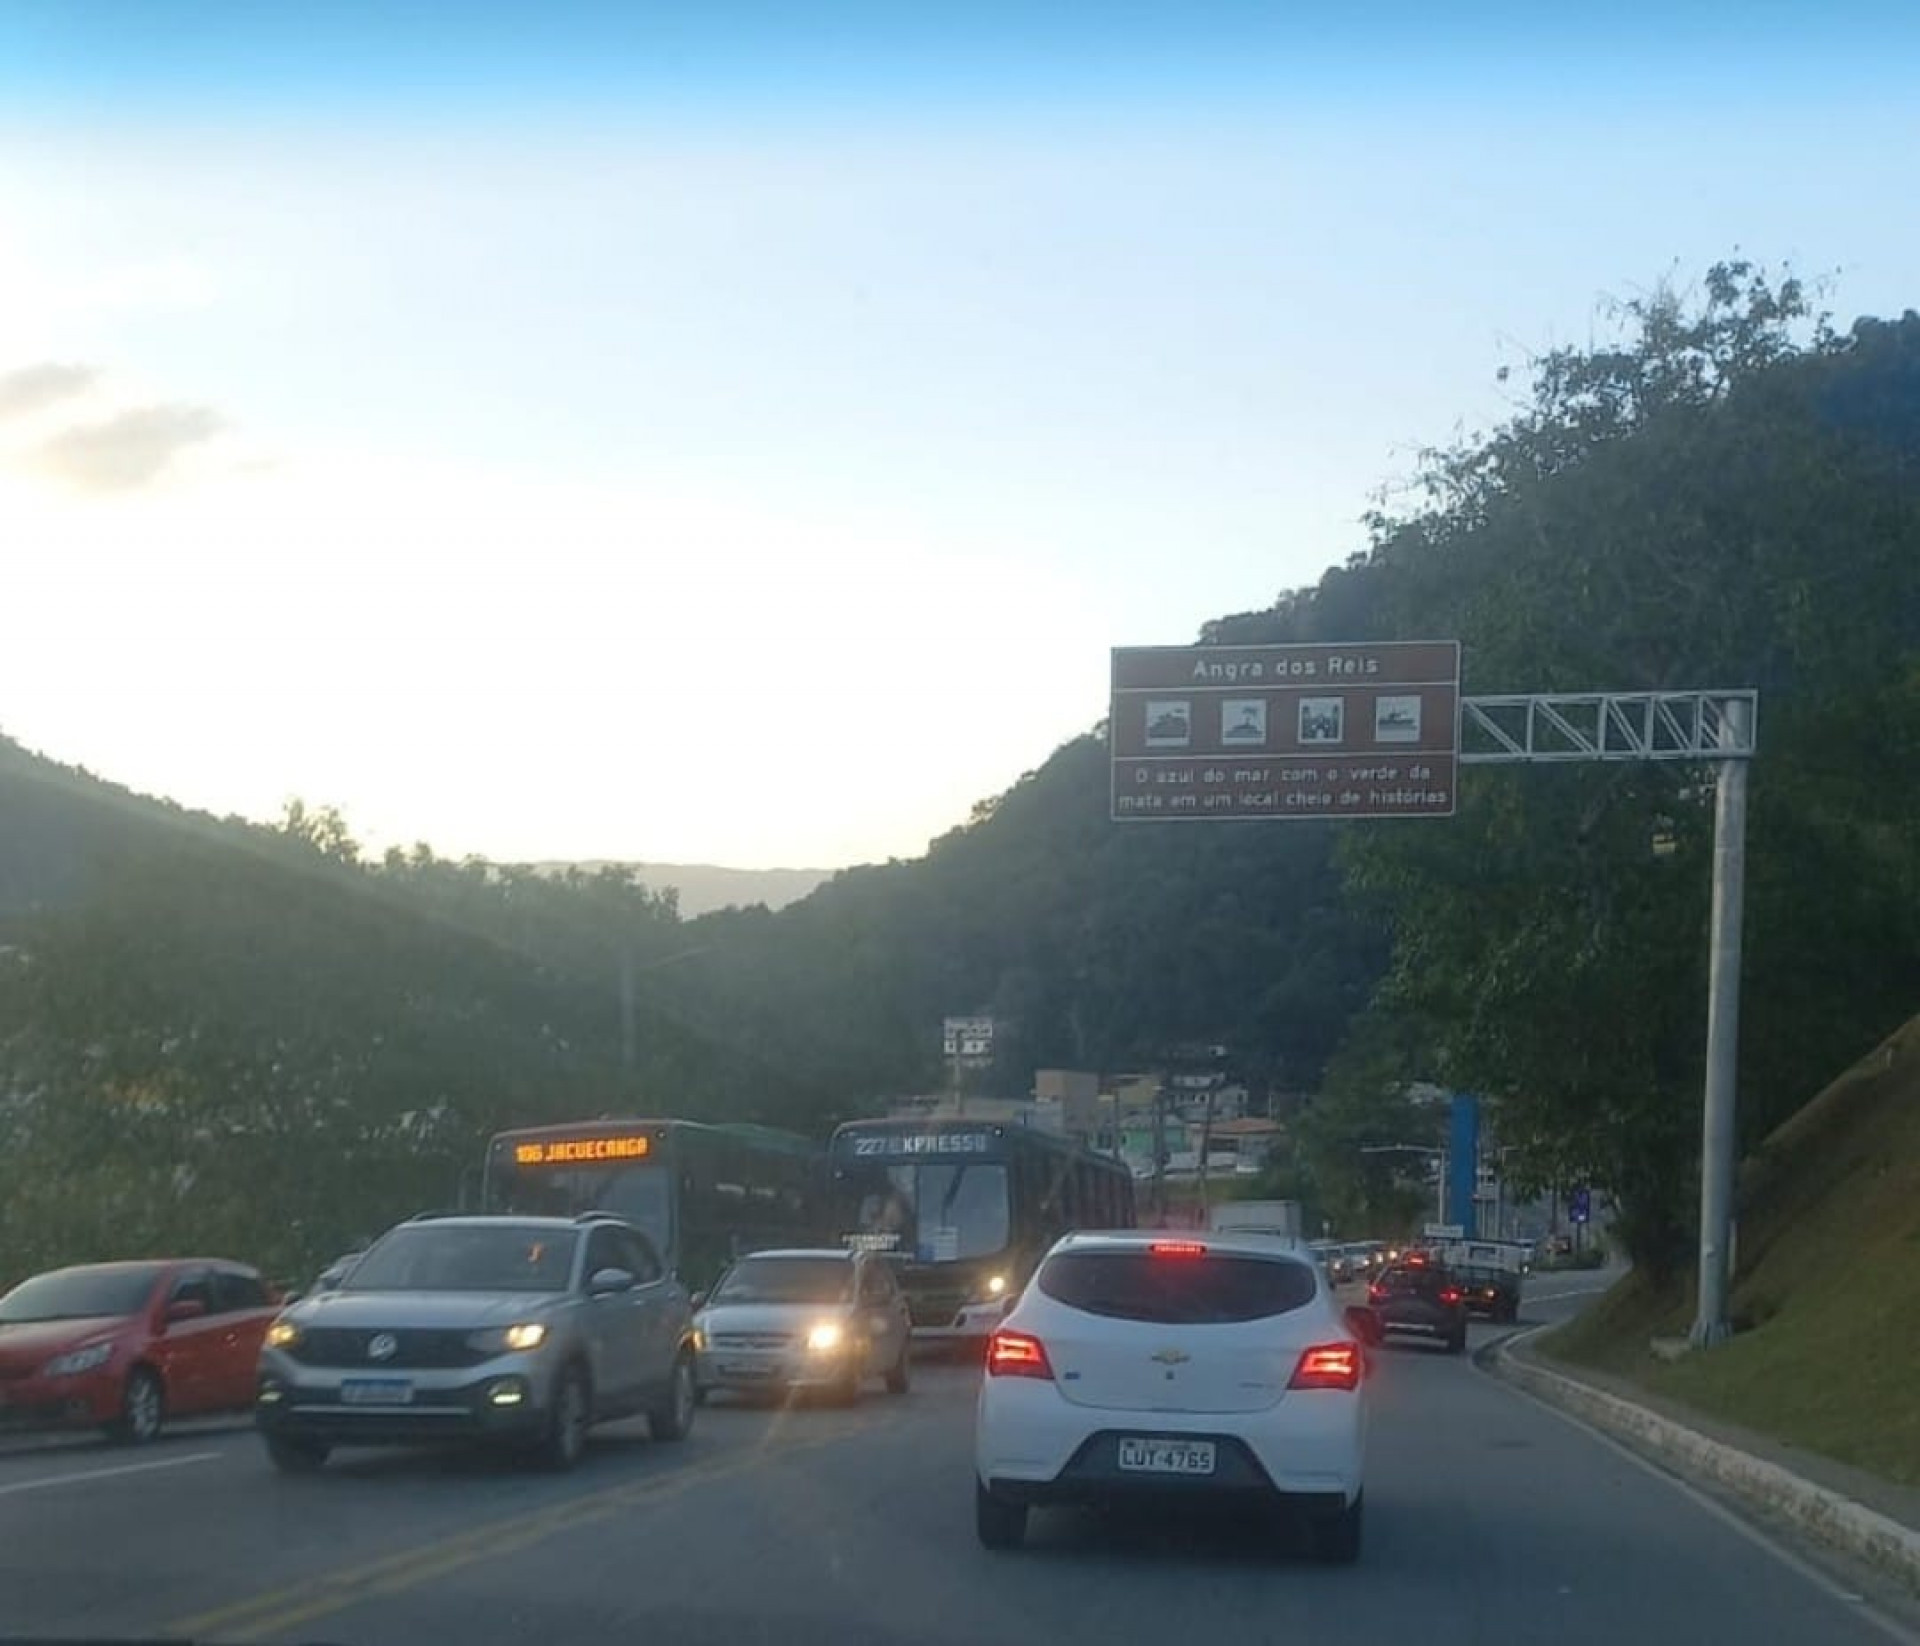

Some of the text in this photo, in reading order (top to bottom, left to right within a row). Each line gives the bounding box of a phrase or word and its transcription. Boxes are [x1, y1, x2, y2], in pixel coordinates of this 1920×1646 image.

[1194, 656, 1380, 681] Angra dos Reis
[1135, 768, 1148, 783] O
[1156, 768, 1194, 783] azul
[1204, 768, 1226, 783] do
[1235, 769, 1270, 783] mar
[1281, 768, 1317, 782] com
[1328, 768, 1338, 781] o
[1351, 766, 1398, 781] verde
[1119, 793, 1162, 808] mata
[1170, 795, 1196, 808] em
[1204, 794, 1231, 808] um
[1239, 791, 1278, 806] local
[1286, 790, 1332, 806] cheio
[1339, 789, 1360, 805] de
